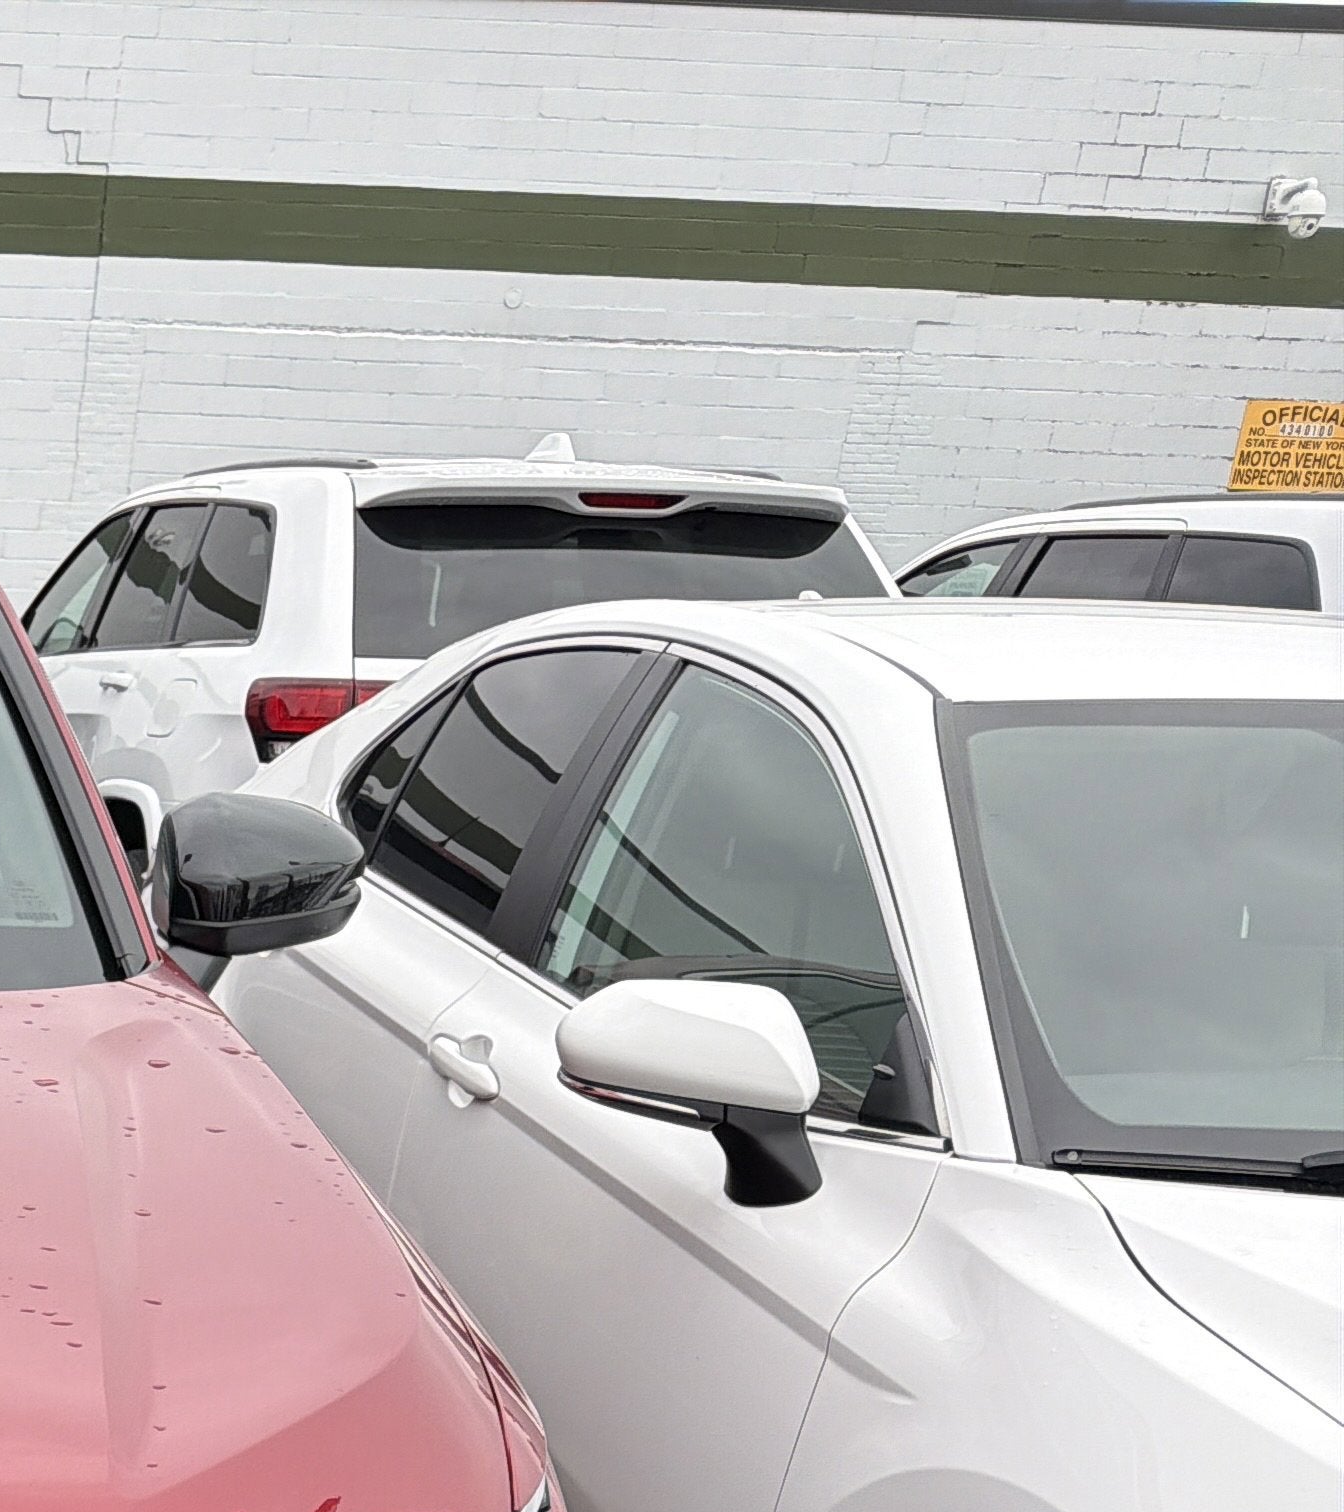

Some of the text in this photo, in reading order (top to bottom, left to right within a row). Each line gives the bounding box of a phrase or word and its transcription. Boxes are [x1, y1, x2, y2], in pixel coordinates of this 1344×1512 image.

[1245, 438, 1279, 449] STATE
[1280, 439, 1297, 449] OF
[1298, 440, 1322, 450] NEW
[1237, 450, 1292, 468] MOTOR
[1231, 468, 1344, 489] INSPECTION STATIO
